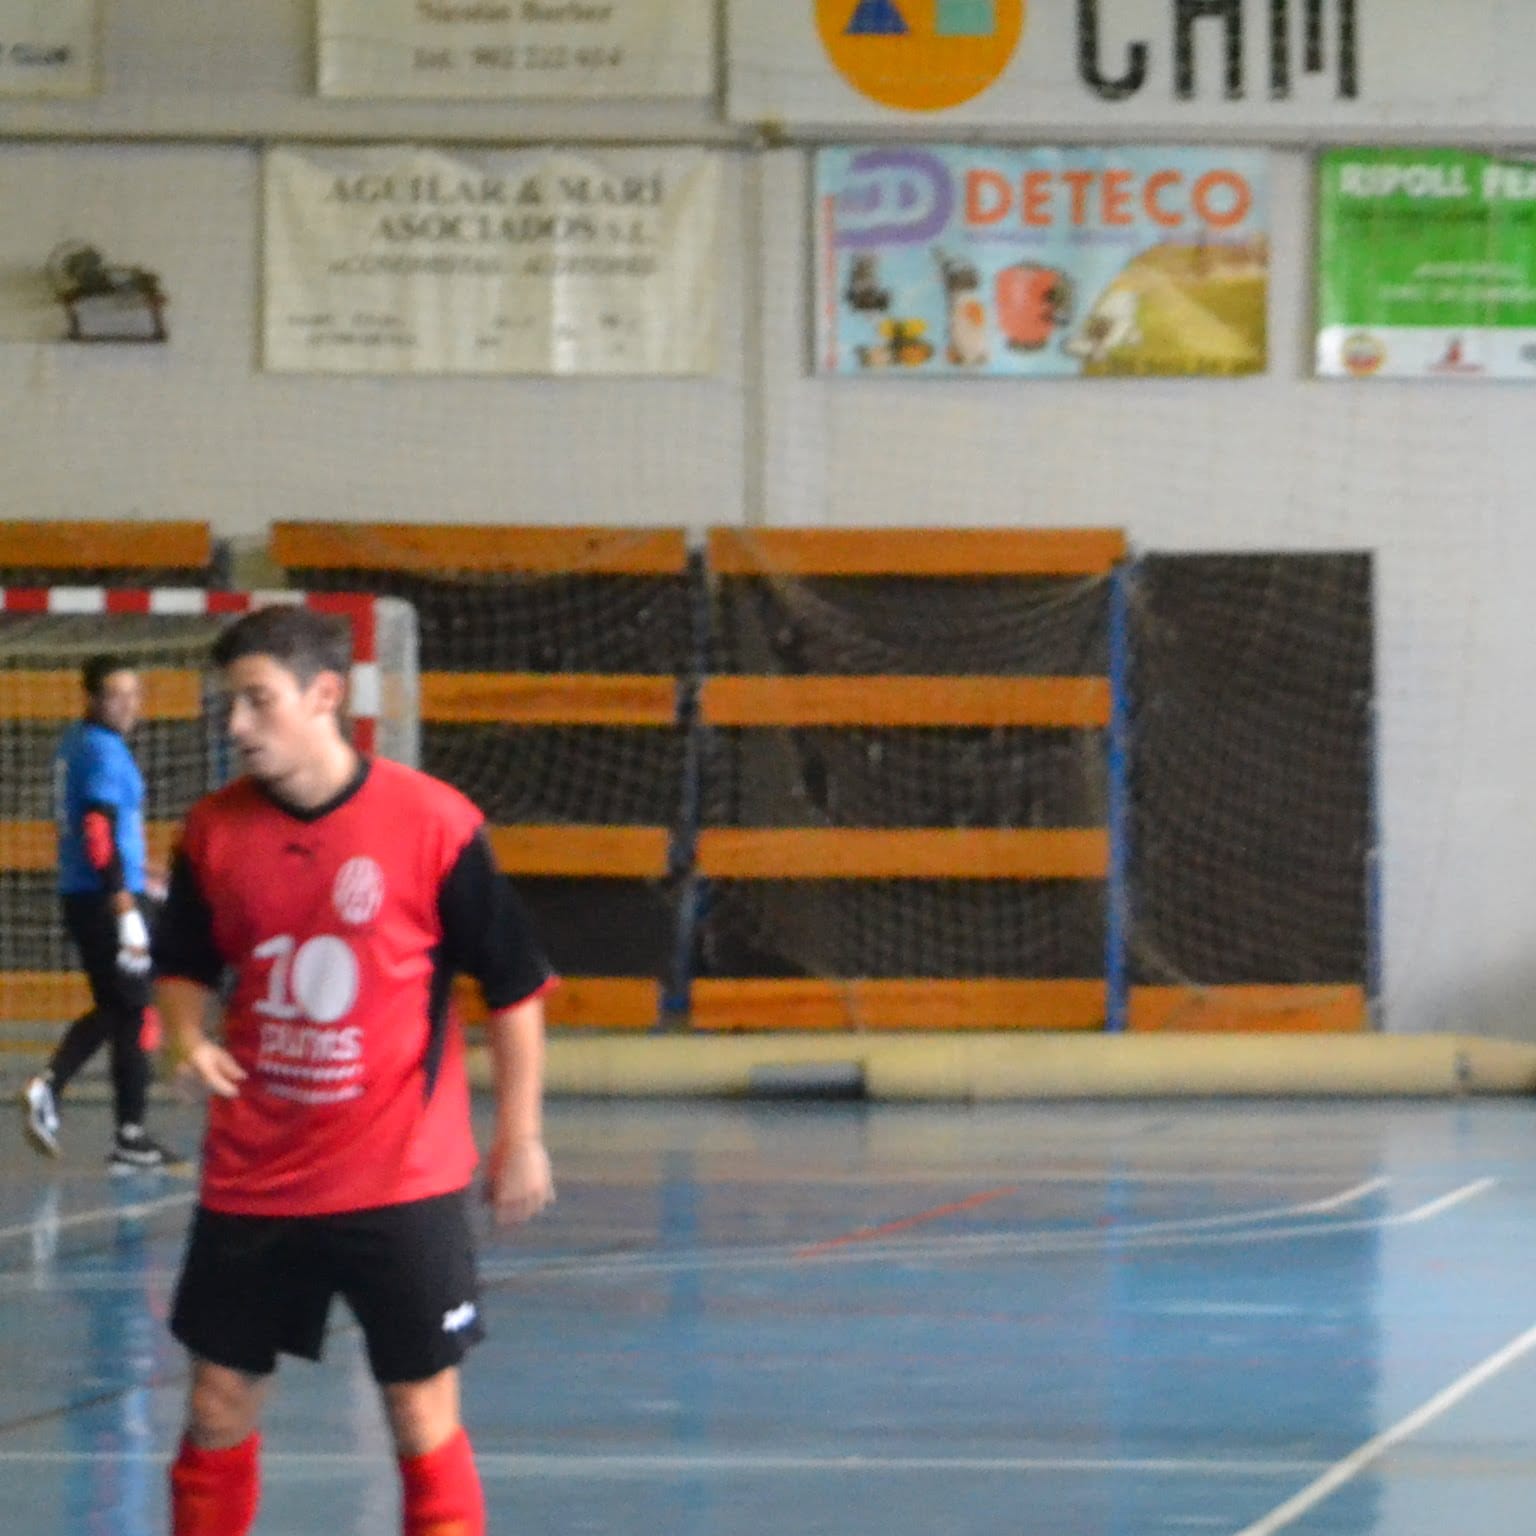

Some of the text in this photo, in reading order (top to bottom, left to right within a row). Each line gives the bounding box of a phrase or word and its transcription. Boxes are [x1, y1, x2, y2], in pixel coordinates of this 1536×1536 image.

[325, 174, 507, 203] AGUILAR
[962, 168, 1253, 227] DETECO
[1338, 162, 1471, 198] RIPOLL
[372, 213, 598, 244] ASOCIADOS
[253, 934, 361, 1024] 10
